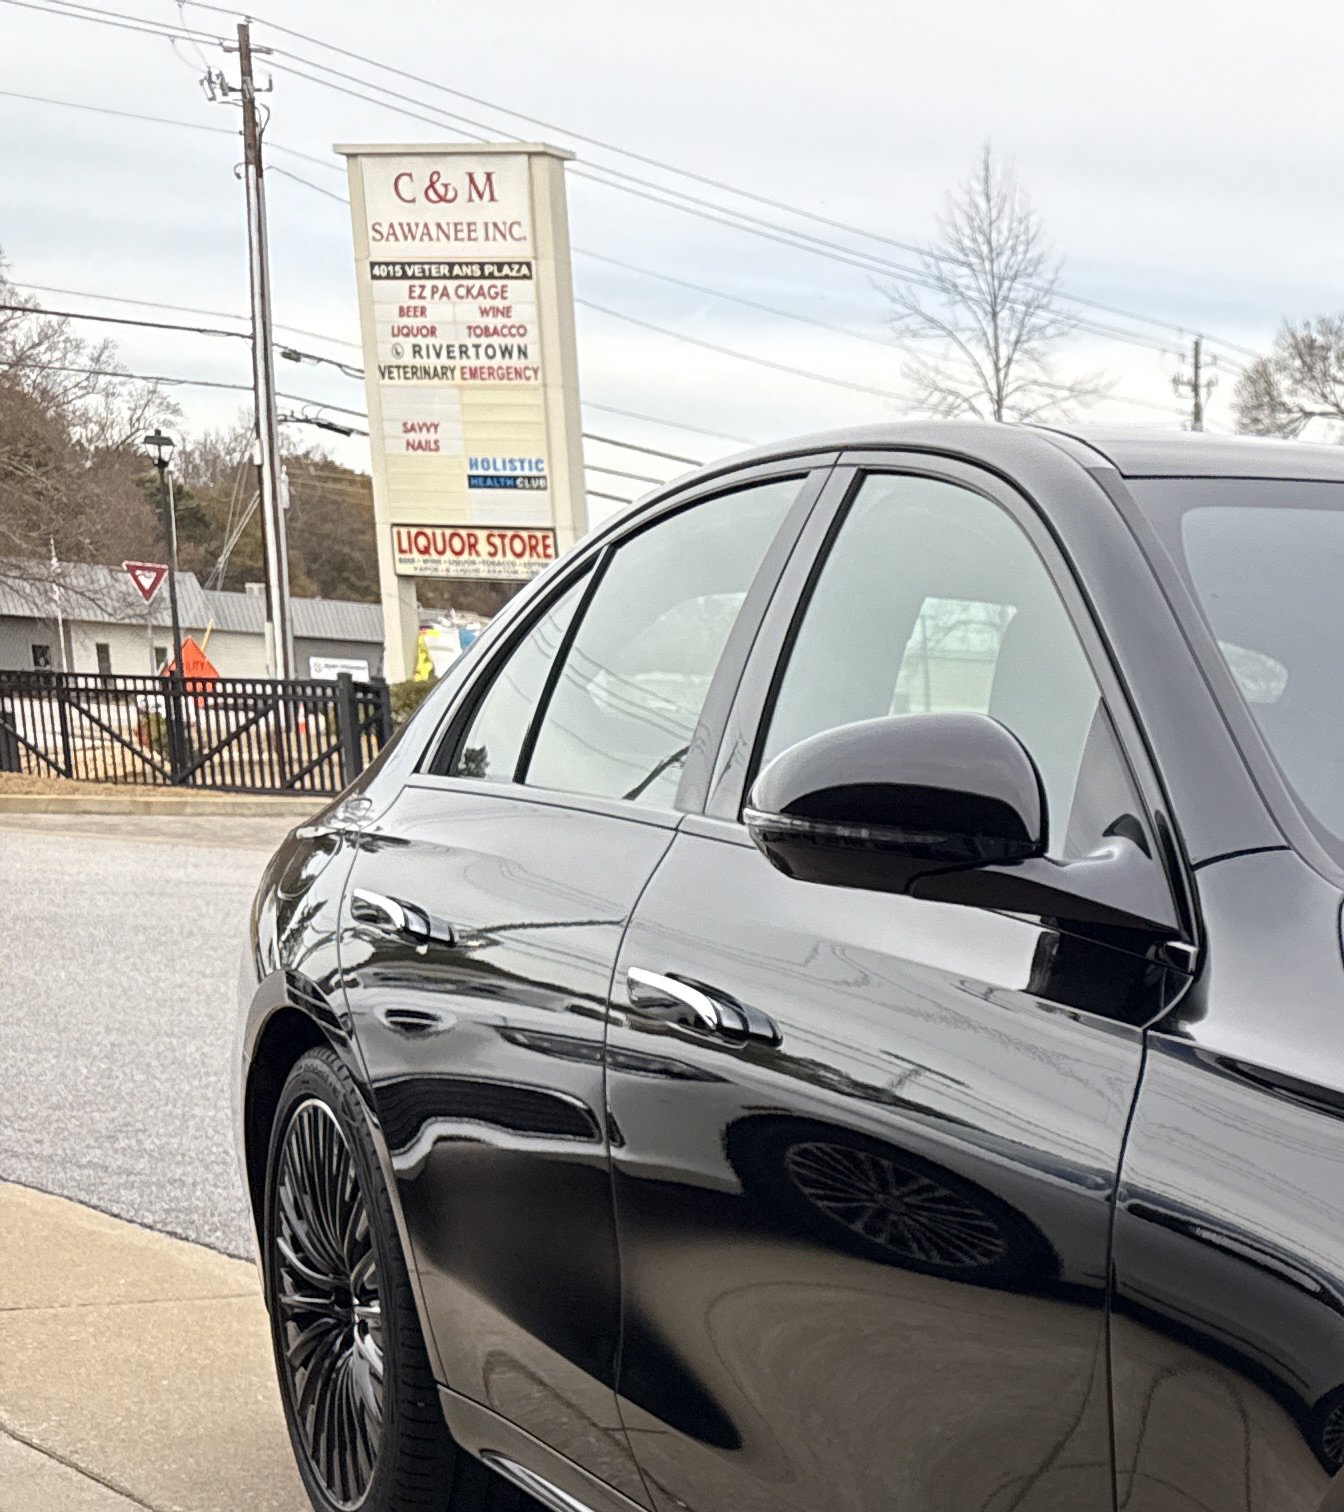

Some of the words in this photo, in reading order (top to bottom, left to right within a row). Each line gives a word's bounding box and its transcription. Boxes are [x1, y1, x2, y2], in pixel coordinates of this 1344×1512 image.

[394, 172, 417, 203] C
[424, 170, 458, 204] &
[465, 171, 499, 203] M
[371, 221, 480, 243] SAWANEE
[484, 221, 527, 242] INC.
[372, 264, 403, 278] 4015
[484, 263, 531, 278] PLAZA
[408, 284, 427, 300] EZ
[398, 305, 427, 318] BEER
[479, 305, 513, 319] WINE
[391, 325, 438, 338] LIQUOR
[466, 324, 528, 338] TOBACCO
[412, 343, 529, 361] RIVERTOWN
[378, 365, 456, 381] VETERINARY
[460, 365, 540, 381] EMERGENCY
[402, 421, 441, 434] SAVVY
[406, 439, 441, 452] NAILS
[469, 457, 545, 472] HOLISTIC
[396, 529, 481, 557] LIQUOR
[486, 533, 553, 559] STORE
